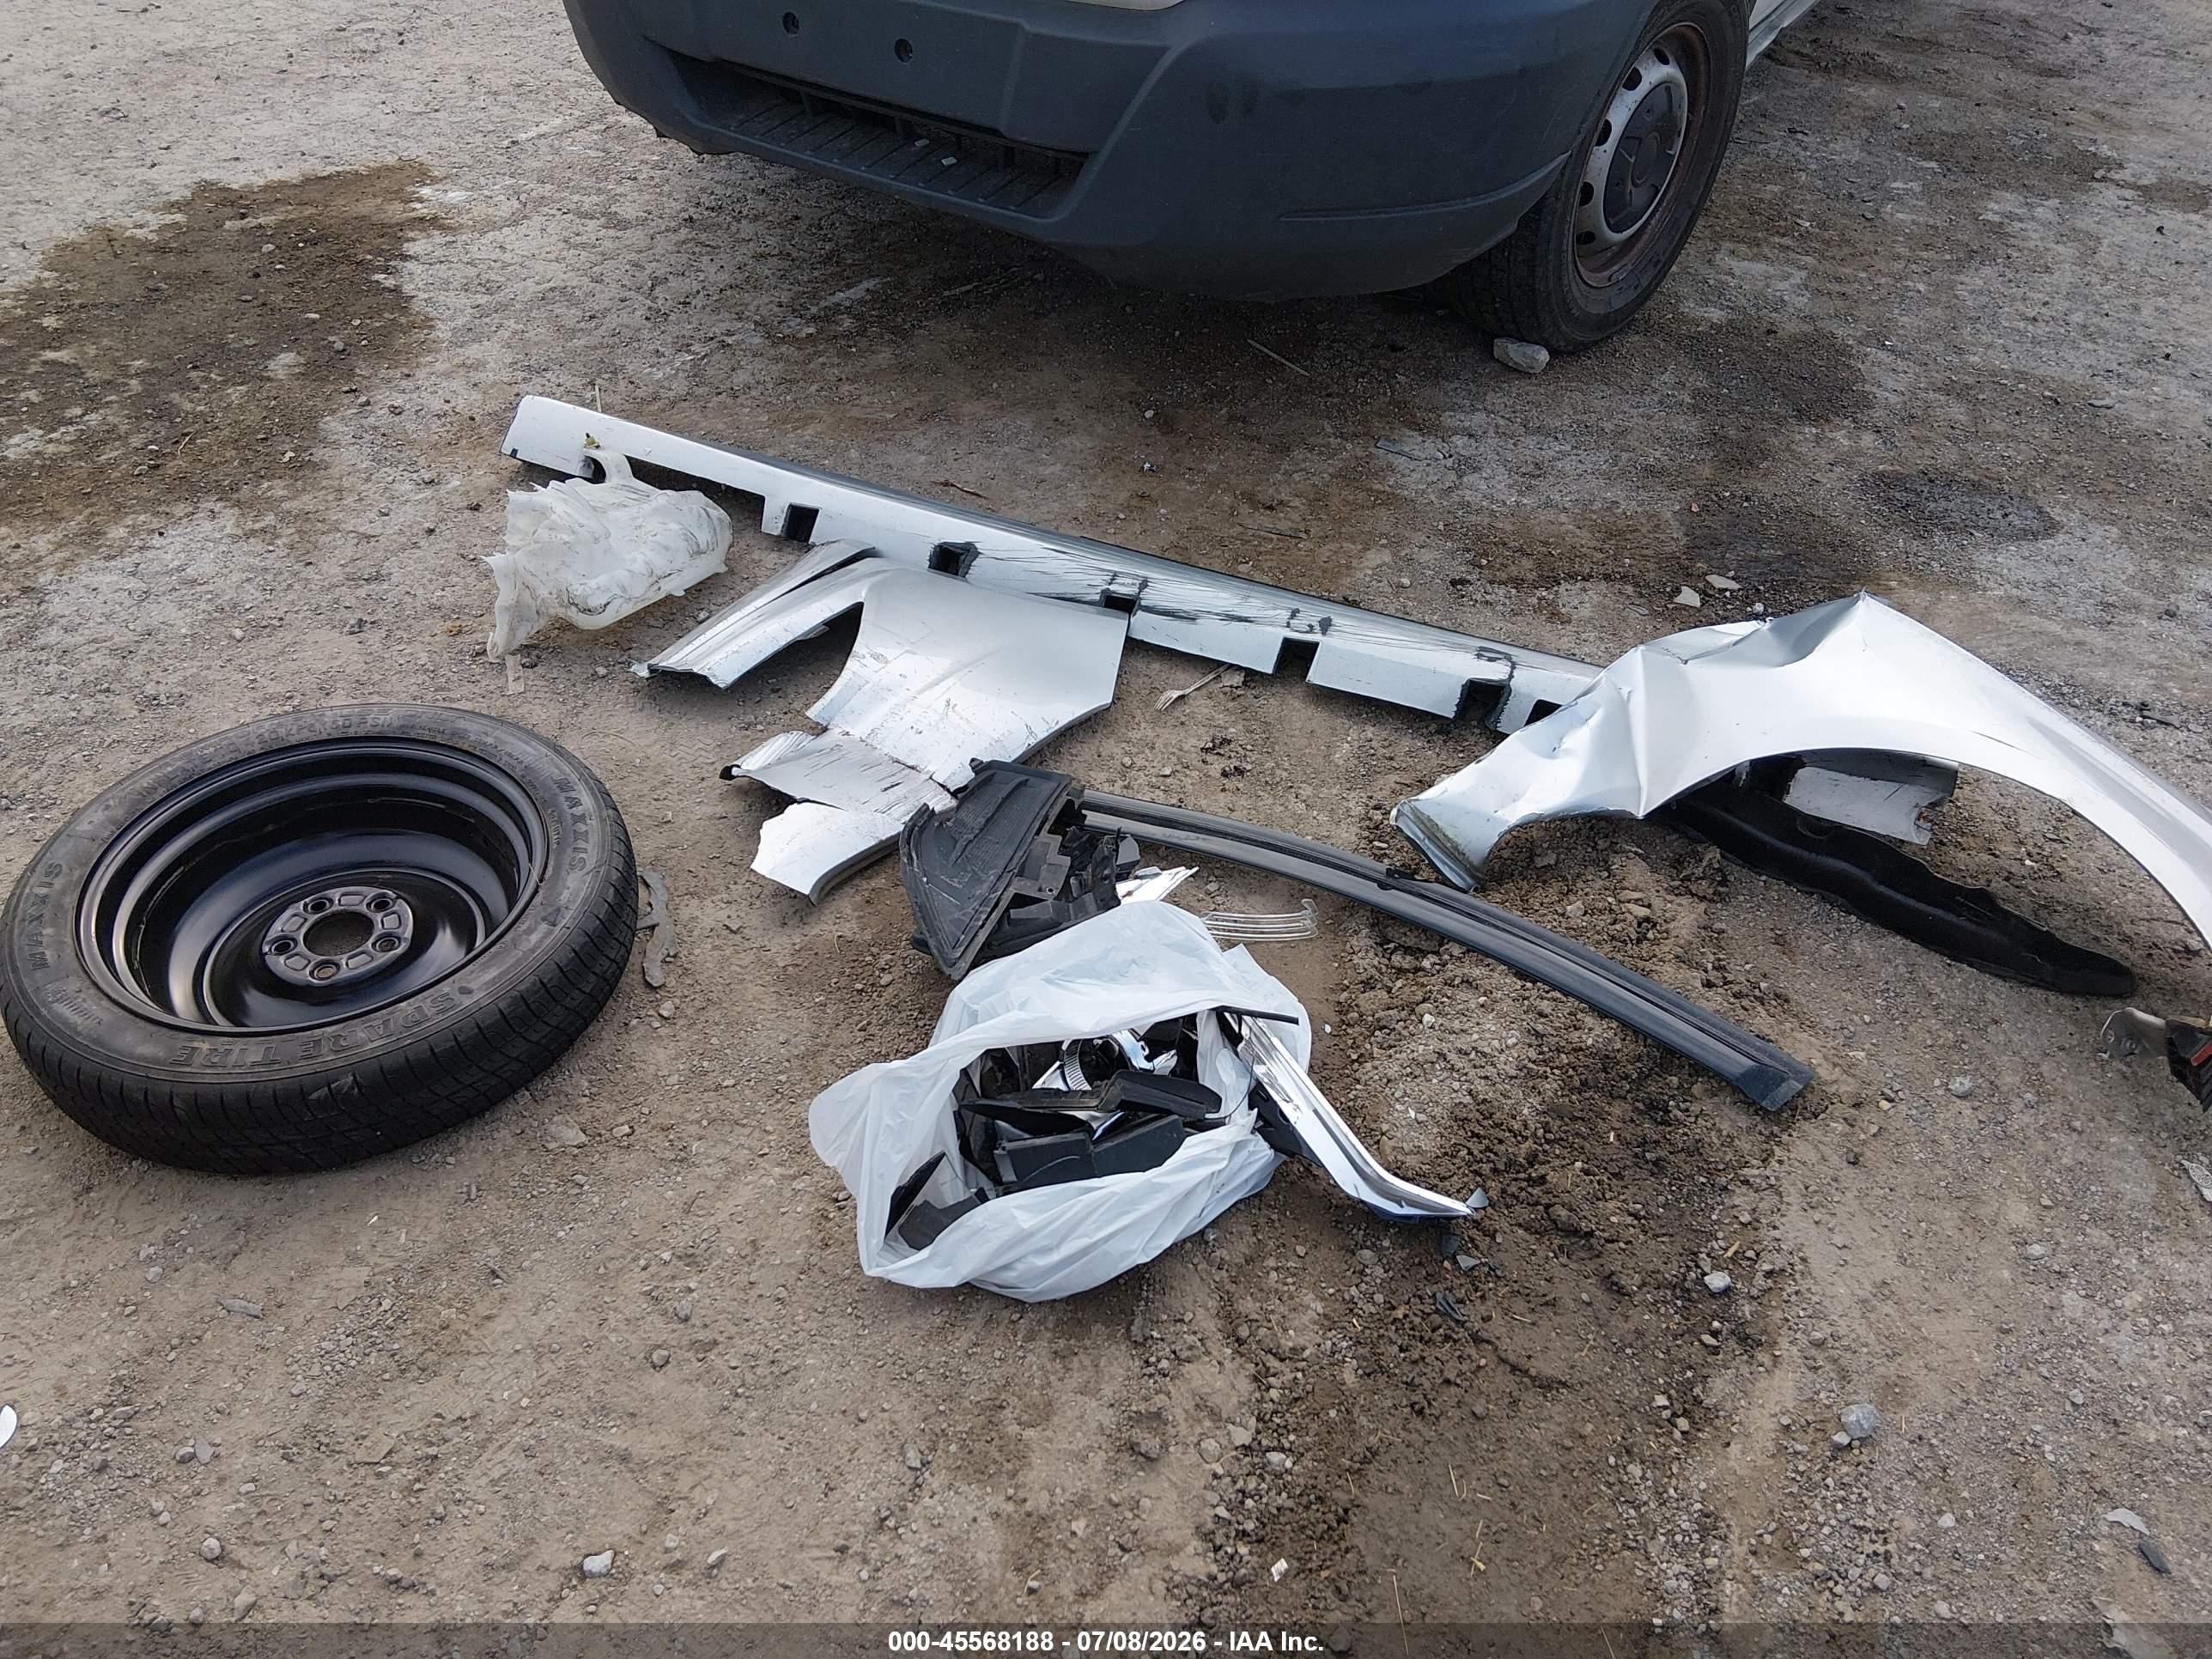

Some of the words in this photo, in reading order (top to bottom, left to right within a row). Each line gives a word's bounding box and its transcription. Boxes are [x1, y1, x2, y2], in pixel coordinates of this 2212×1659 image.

[552, 776, 590, 871] MAXXIS
[27, 861, 63, 971] MAXXIS
[170, 1043, 282, 1066] TIRE
[300, 991, 459, 1060] SPARE
